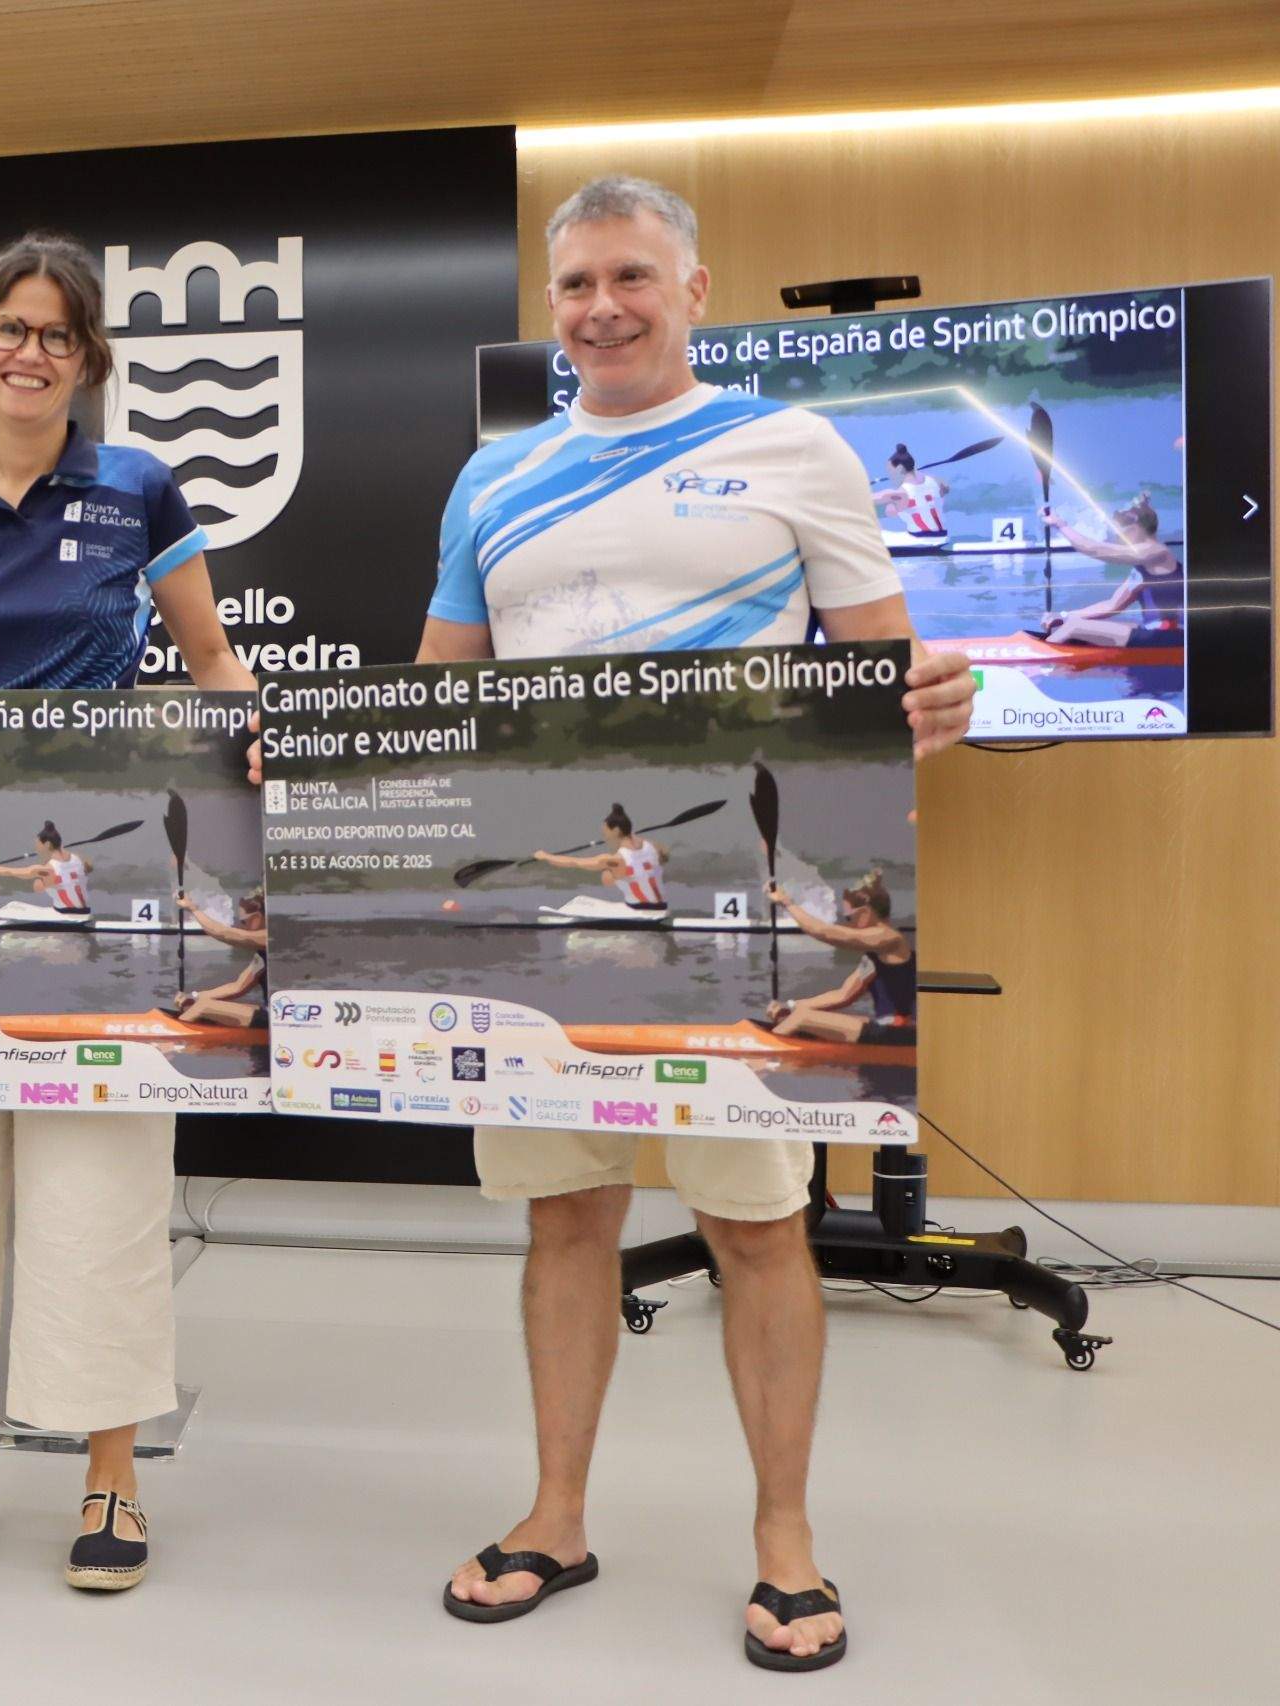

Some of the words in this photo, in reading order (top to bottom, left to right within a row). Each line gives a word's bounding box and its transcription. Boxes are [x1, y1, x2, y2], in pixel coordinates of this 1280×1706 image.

[736, 330, 769, 361] de
[779, 323, 882, 364] España
[889, 318, 925, 348] de
[933, 311, 1025, 354] Sprint
[1032, 301, 1176, 341] Olímpico
[677, 479, 748, 495] FGP
[85, 502, 119, 516] XUNTA
[83, 513, 96, 523] DE
[100, 516, 142, 528] GALICIA
[1000, 522, 1016, 541] 4
[138, 635, 361, 673] onvedra
[262, 678, 426, 719] Campionato
[434, 671, 469, 706] de
[478, 666, 585, 710] España
[593, 662, 631, 696] de
[639, 659, 737, 704] Sprint
[744, 651, 896, 697] Olímpico
[32, 699, 65, 728] de
[72, 700, 155, 736] Sprint
[162, 698, 252, 737] Olímpi
[1003, 707, 1124, 728] DingoNatura
[263, 725, 348, 758] Sénior
[355, 733, 370, 754] e
[377, 717, 477, 753] xuvenil
[291, 782, 338, 795] XUNTA
[440, 779, 451, 787] DE
[379, 789, 437, 798] PRESIDENCIA,
[291, 798, 308, 810] DE
[312, 797, 368, 809] GALICIA
[380, 800, 416, 808] XUSTIZA
[419, 799, 424, 807] E
[426, 798, 471, 807] DEPORTES
[267, 827, 331, 840] COMPLEXO
[335, 825, 404, 839] DEPORTIVO
[408, 825, 447, 838] DAVID
[451, 824, 475, 837] CAL
[269, 857, 277, 871] 1,
[281, 857, 287, 869] 2
[291, 856, 297, 868] E
[301, 856, 307, 868] 3
[311, 856, 326, 868] DE
[329, 855, 380, 868] AGOSTO
[383, 855, 400, 868] DE
[403, 855, 432, 868] 2025
[138, 902, 153, 921] 4
[723, 897, 739, 918] 4
[93, 1050, 115, 1059] ence
[561, 1063, 644, 1078] infisport
[674, 1065, 699, 1077] ence
[139, 1082, 248, 1101] DingoNatura
[536, 1098, 581, 1110] DEPORTE
[536, 1110, 578, 1122] GALEGO
[727, 1104, 856, 1127] DingoNatura
